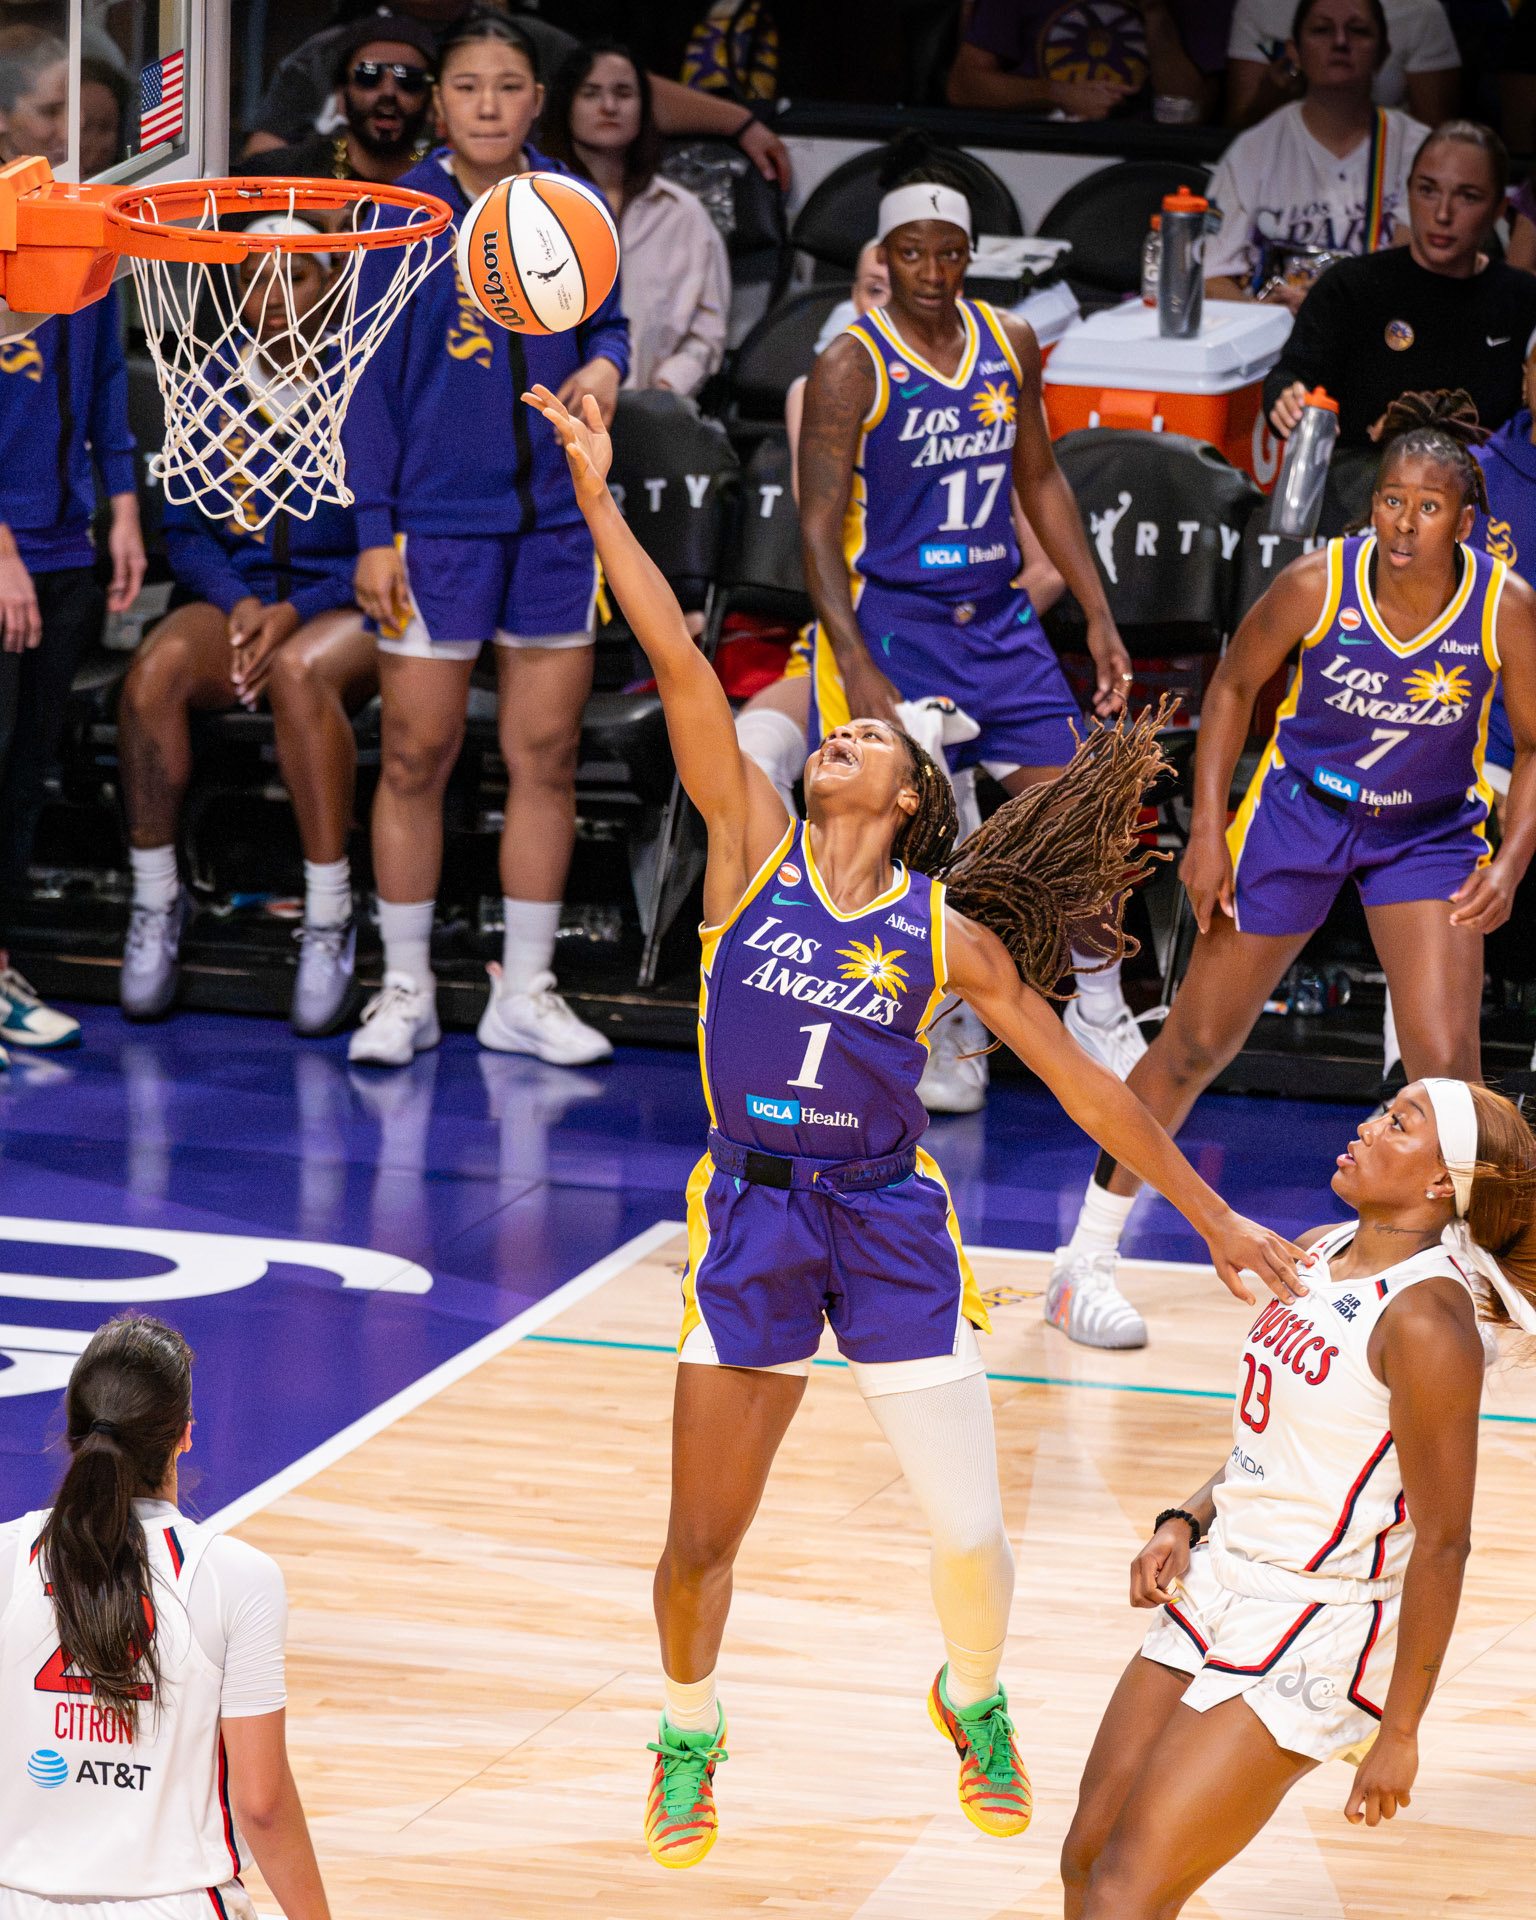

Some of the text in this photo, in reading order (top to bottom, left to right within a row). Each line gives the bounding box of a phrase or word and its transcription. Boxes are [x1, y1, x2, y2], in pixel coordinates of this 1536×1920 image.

[483, 229, 526, 327] Wilson
[898, 406, 960, 442] LOS
[938, 463, 1006, 532] 17
[925, 544, 1007, 565] UCLA Health
[1438, 639, 1480, 656] Albert
[1320, 654, 1390, 695] LOS
[1324, 687, 1470, 726] ANGELES
[1354, 728, 1410, 770] 7
[1318, 771, 1413, 807] UCLA Health
[743, 916, 822, 964] LOS
[884, 912, 928, 940] Albert
[742, 957, 902, 1026] ANGELES
[786, 1022, 832, 1090] 1
[752, 1100, 860, 1129] UCLA Health
[1331, 1299, 1357, 1323] max
[1342, 1293, 1362, 1310] CAR
[1240, 1352, 1272, 1434] 23
[55, 1701, 134, 1745] CITRON
[75, 1759, 152, 1791] AT&T
